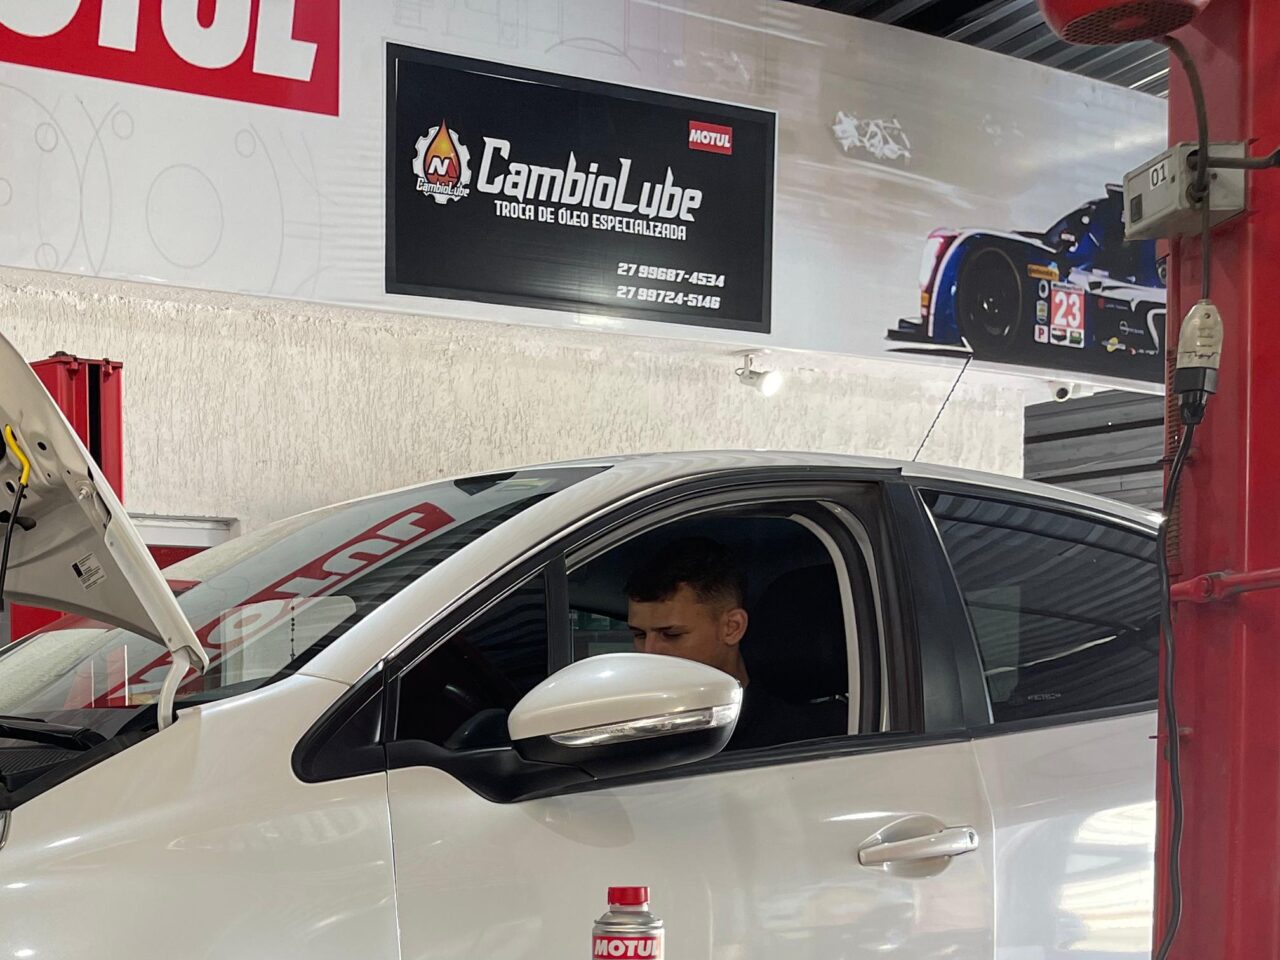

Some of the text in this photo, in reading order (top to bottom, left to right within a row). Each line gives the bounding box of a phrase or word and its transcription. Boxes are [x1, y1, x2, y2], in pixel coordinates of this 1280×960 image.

[689, 129, 731, 148] MOTUL
[416, 178, 470, 197] CambioLube
[477, 136, 703, 222] CambioLube
[1151, 163, 1167, 187] 01
[494, 200, 687, 241] TROCA DE ÓLEO ESPECIALIZADA
[617, 262, 726, 288] 27 99687-4534
[617, 285, 720, 310] 27 99724-5146
[1055, 291, 1080, 328] 23
